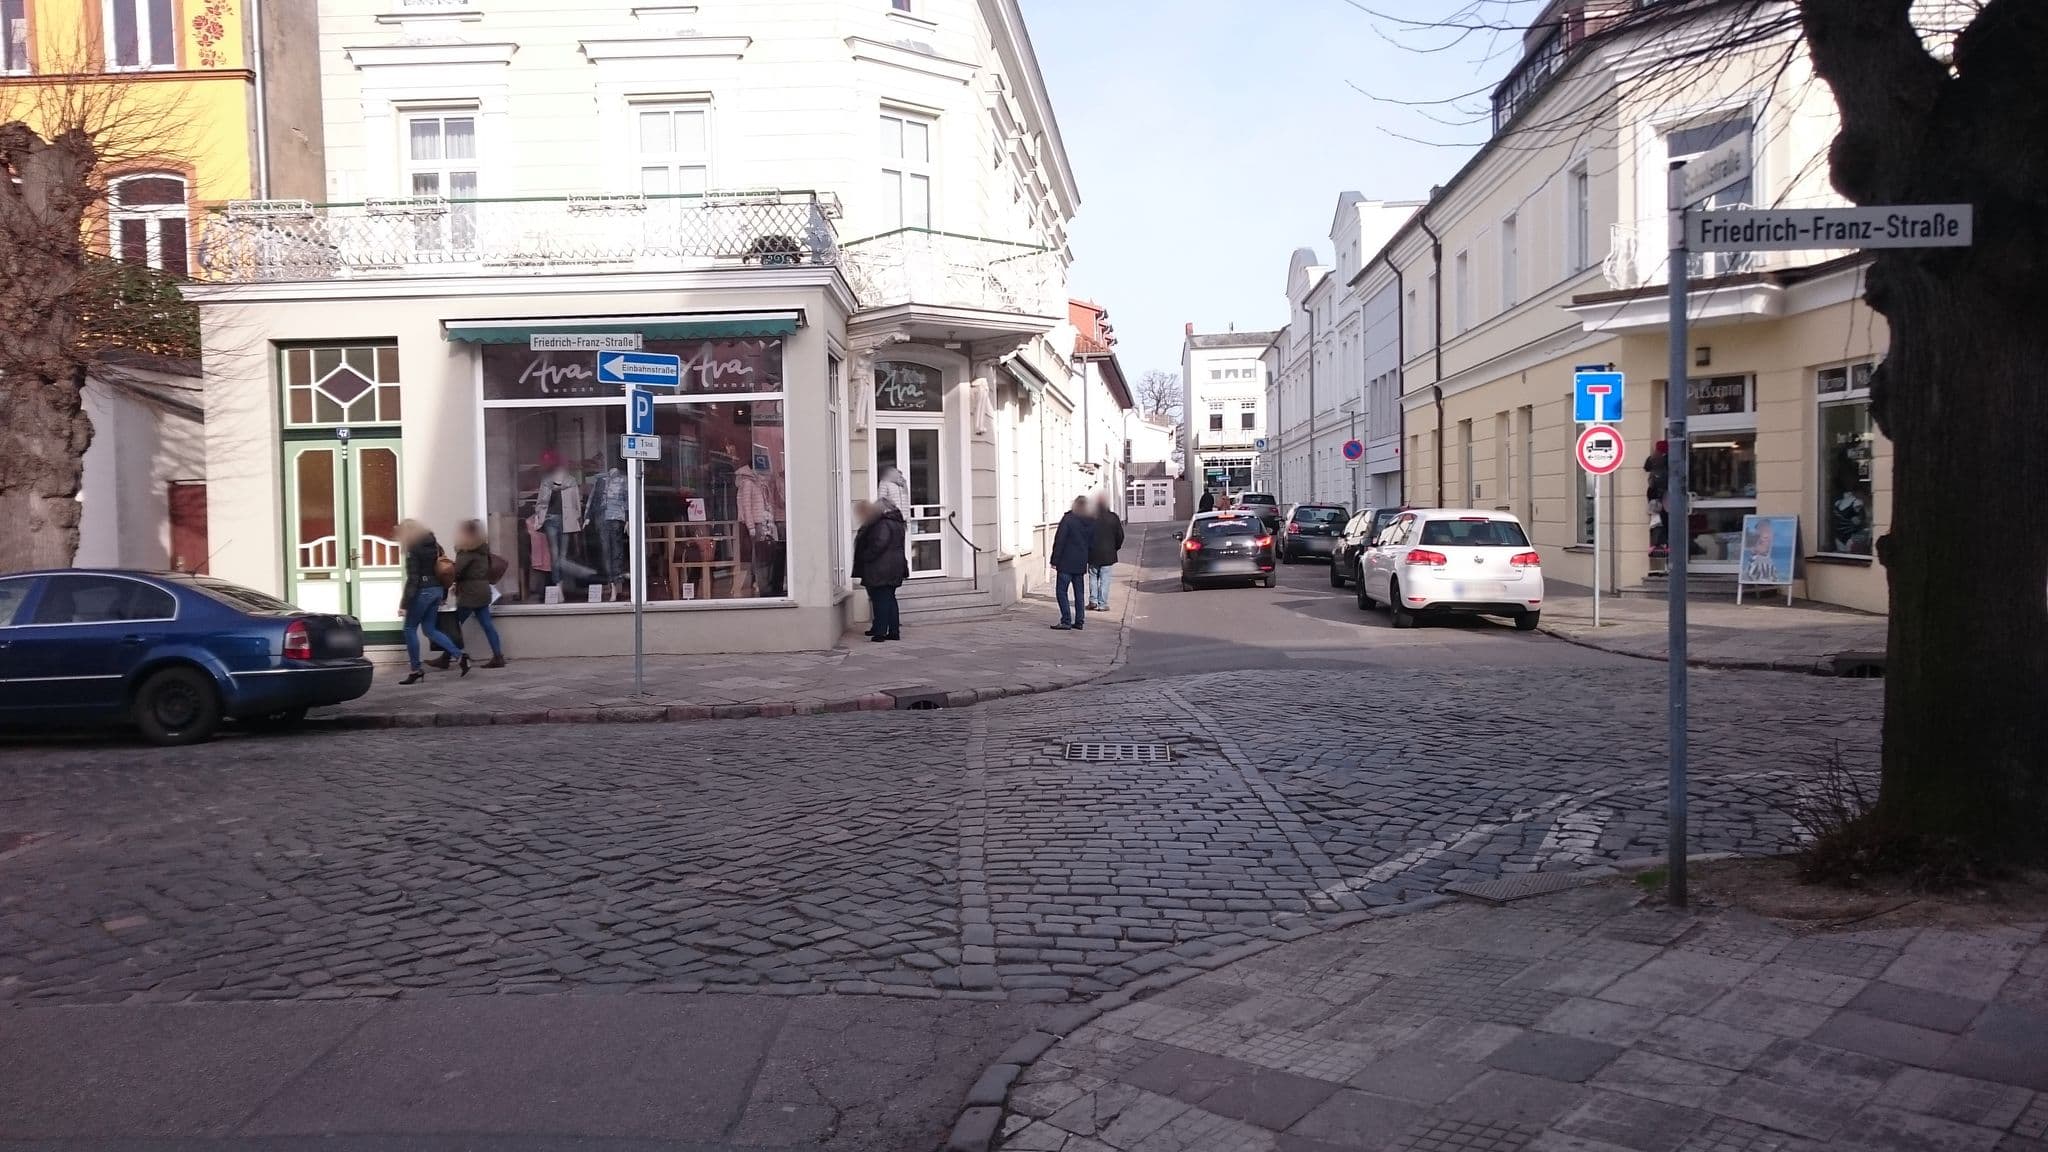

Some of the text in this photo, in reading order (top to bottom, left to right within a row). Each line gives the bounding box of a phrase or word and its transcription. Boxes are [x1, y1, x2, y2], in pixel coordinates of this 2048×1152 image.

[1701, 213, 1959, 243] Friedrich-Franz-Straße
[533, 337, 634, 348] Friedrich-Franz-Straße
[518, 354, 593, 393] Ava
[622, 363, 675, 375] Einbahnstraße
[680, 347, 753, 387] Ava
[876, 370, 924, 406] Ava
[636, 396, 648, 429] P
